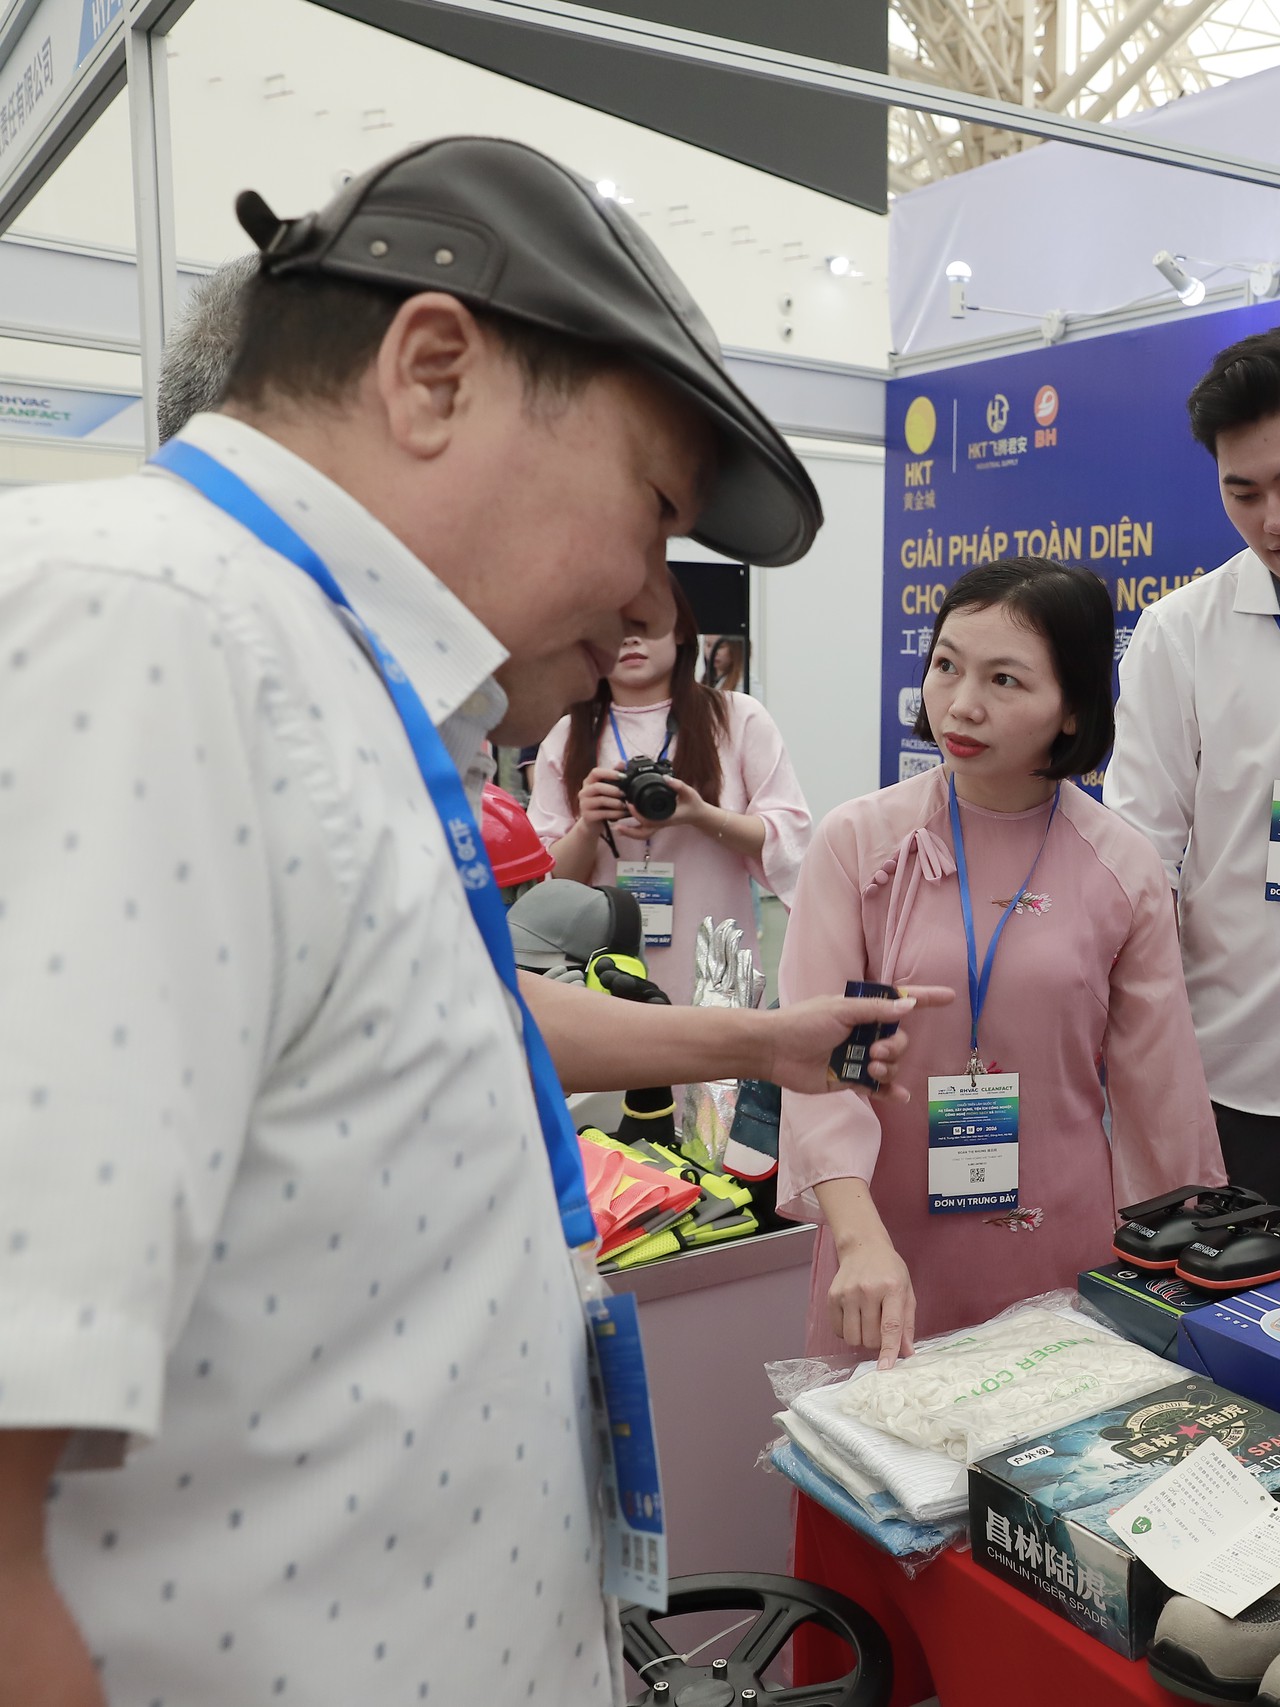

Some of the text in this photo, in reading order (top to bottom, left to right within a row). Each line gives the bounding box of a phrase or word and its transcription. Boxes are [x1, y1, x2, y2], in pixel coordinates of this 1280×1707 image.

[1034, 428, 1057, 448] BH
[968, 441, 987, 459] HKT
[905, 460, 934, 487] HKT
[901, 516, 1154, 569] GIẢI PHÁP TOÀN DIỆN
[902, 584, 946, 615] CHO
[934, 1197, 955, 1208] ĐƠN
[957, 1198, 966, 1208] VỊ
[1000, 1194, 1016, 1204] BÀY
[1155, 1402, 1184, 1411] SPADE
[1127, 1403, 1249, 1457] 昌林 陆虎
[1013, 1447, 1052, 1465] 户外级
[1135, 1518, 1148, 1532] LA
[986, 1506, 1107, 1611] 昌林陆虎
[987, 1546, 1108, 1629] CHINLIN TIGER SPADE
